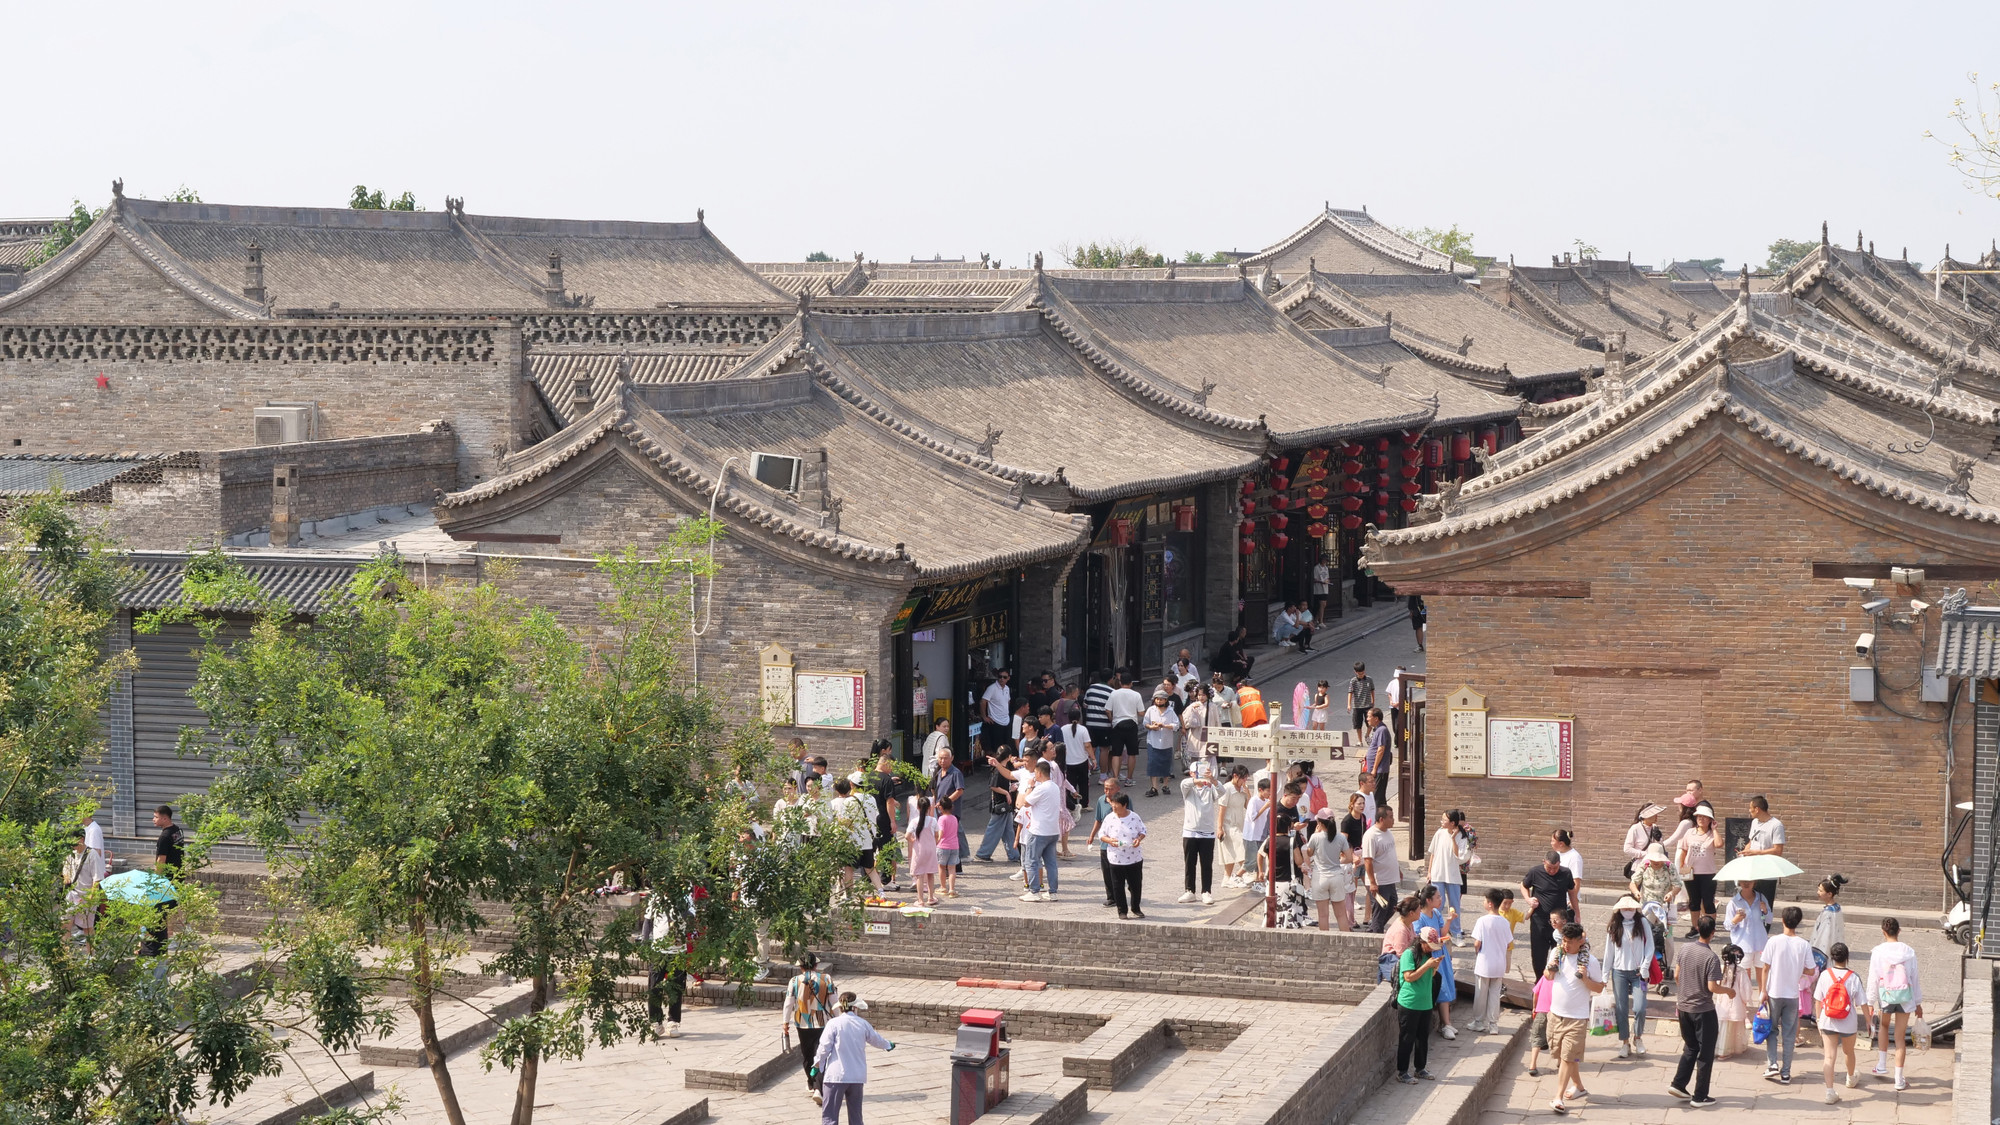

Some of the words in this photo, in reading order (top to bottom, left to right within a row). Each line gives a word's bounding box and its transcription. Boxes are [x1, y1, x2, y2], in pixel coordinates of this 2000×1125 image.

[1218, 728, 1259, 739] 西南门头街
[1289, 731, 1331, 741] 东南门头街
